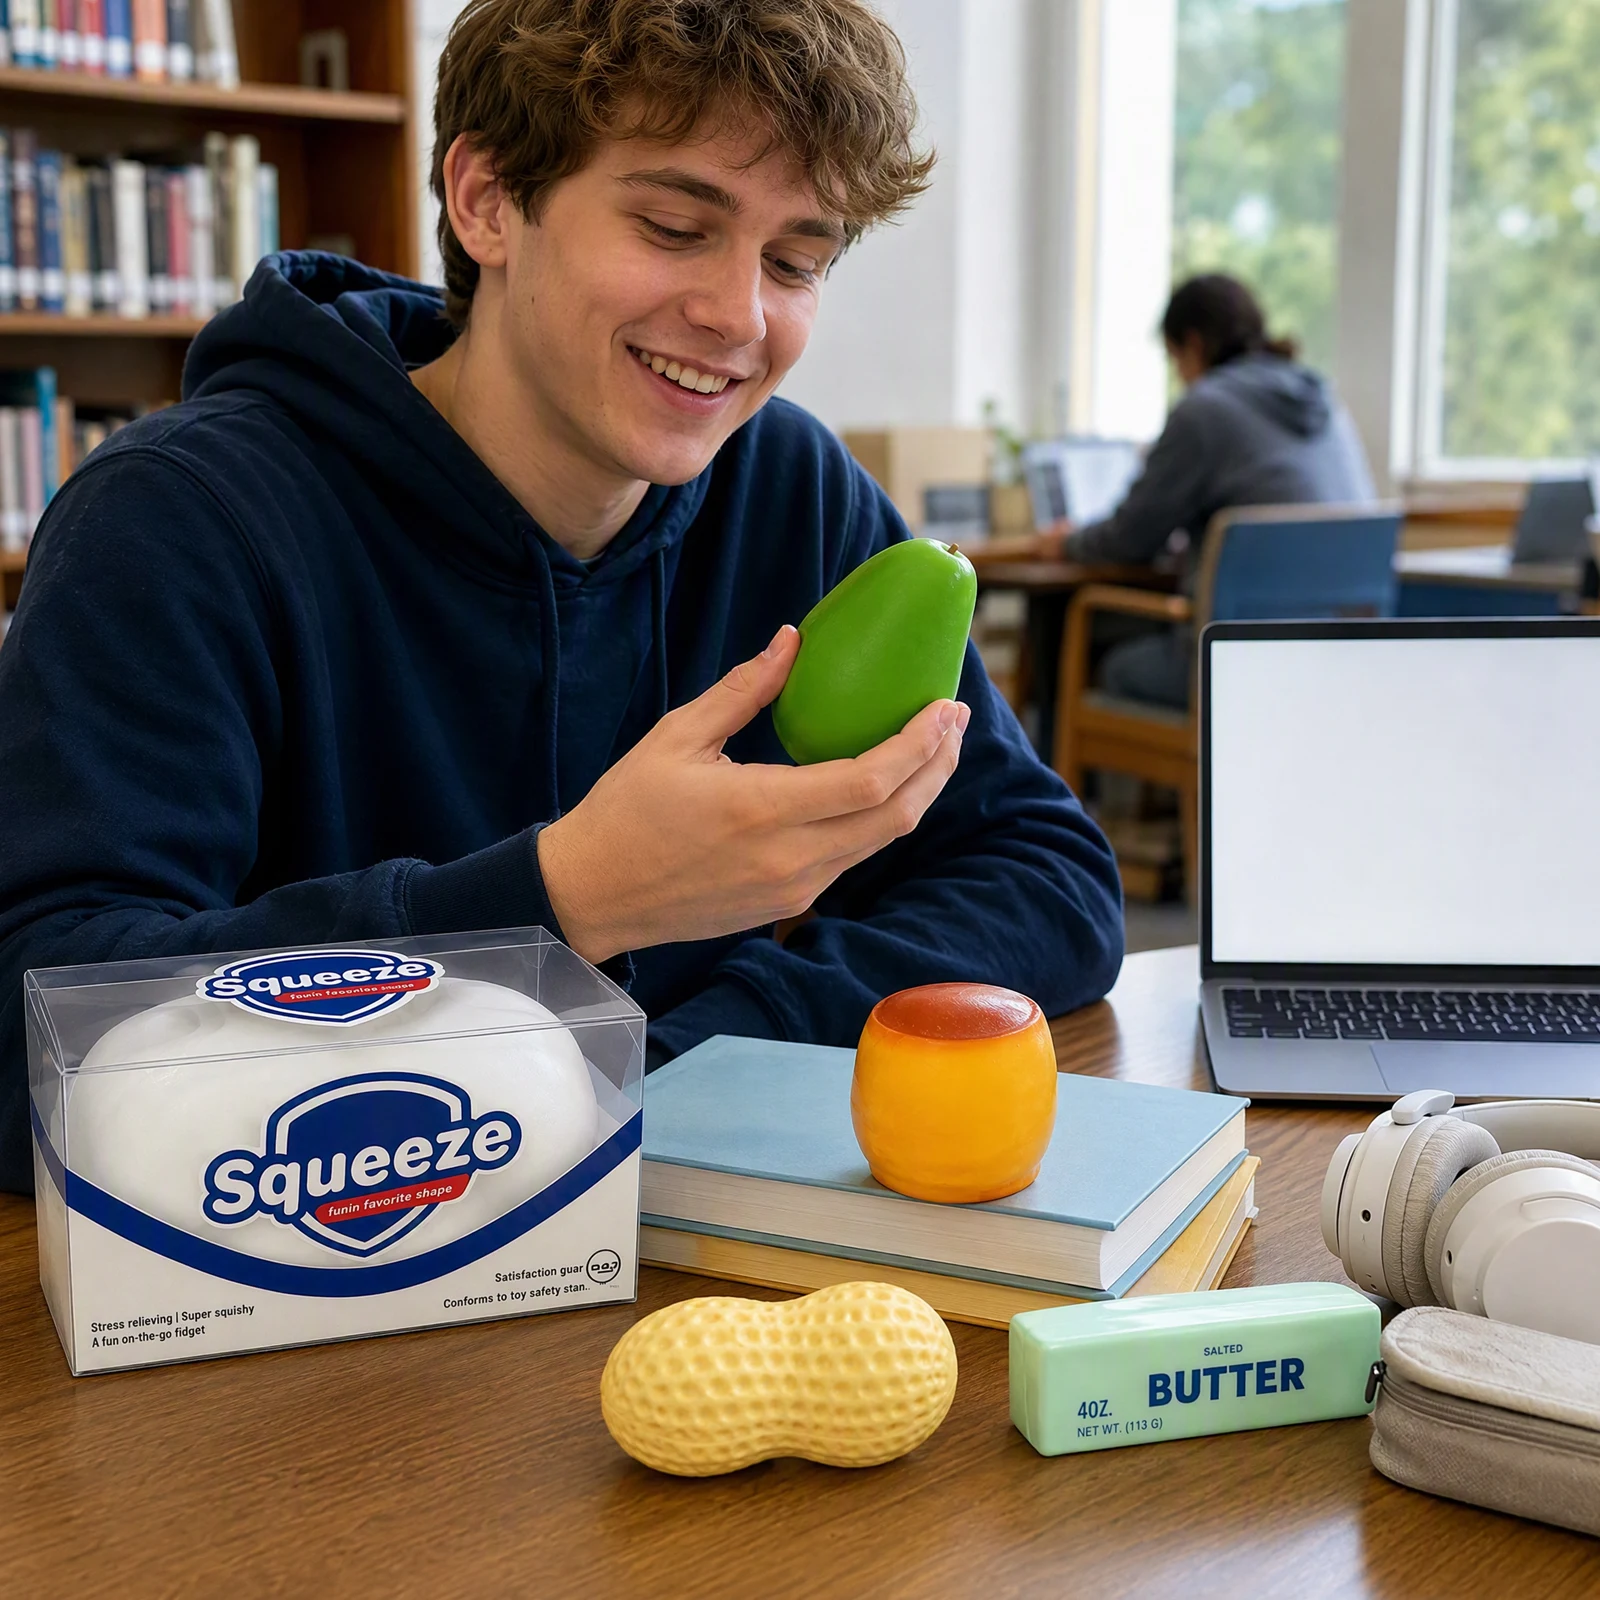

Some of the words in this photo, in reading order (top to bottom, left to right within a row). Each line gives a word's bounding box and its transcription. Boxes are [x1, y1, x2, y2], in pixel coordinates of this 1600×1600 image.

[212, 962, 428, 996] Squeeze
[212, 1120, 512, 1215] Squeeze
[328, 1203, 360, 1217] funin
[363, 1193, 412, 1210] favorite
[415, 1184, 453, 1200] shape
[495, 1267, 557, 1283] Satisfaction
[560, 1264, 584, 1278] guar
[443, 1294, 494, 1309] Conforms
[497, 1292, 508, 1302] to
[510, 1289, 527, 1301] toy
[529, 1285, 561, 1299] safety
[91, 1321, 125, 1333] Stress
[127, 1314, 173, 1328] relieving
[181, 1309, 212, 1323] Super
[214, 1304, 255, 1318] squishy
[92, 1337, 100, 1348] A
[102, 1336, 119, 1347] fun
[121, 1331, 172, 1345] on-the-go
[174, 1325, 206, 1338] fidget
[1203, 1344, 1243, 1356] SALTED
[1148, 1357, 1305, 1407] BUTTER
[1077, 1425, 1100, 1438] NET
[1102, 1423, 1122, 1434] WT.
[1125, 1420, 1148, 1434] (113
[1150, 1417, 1164, 1430] G)
